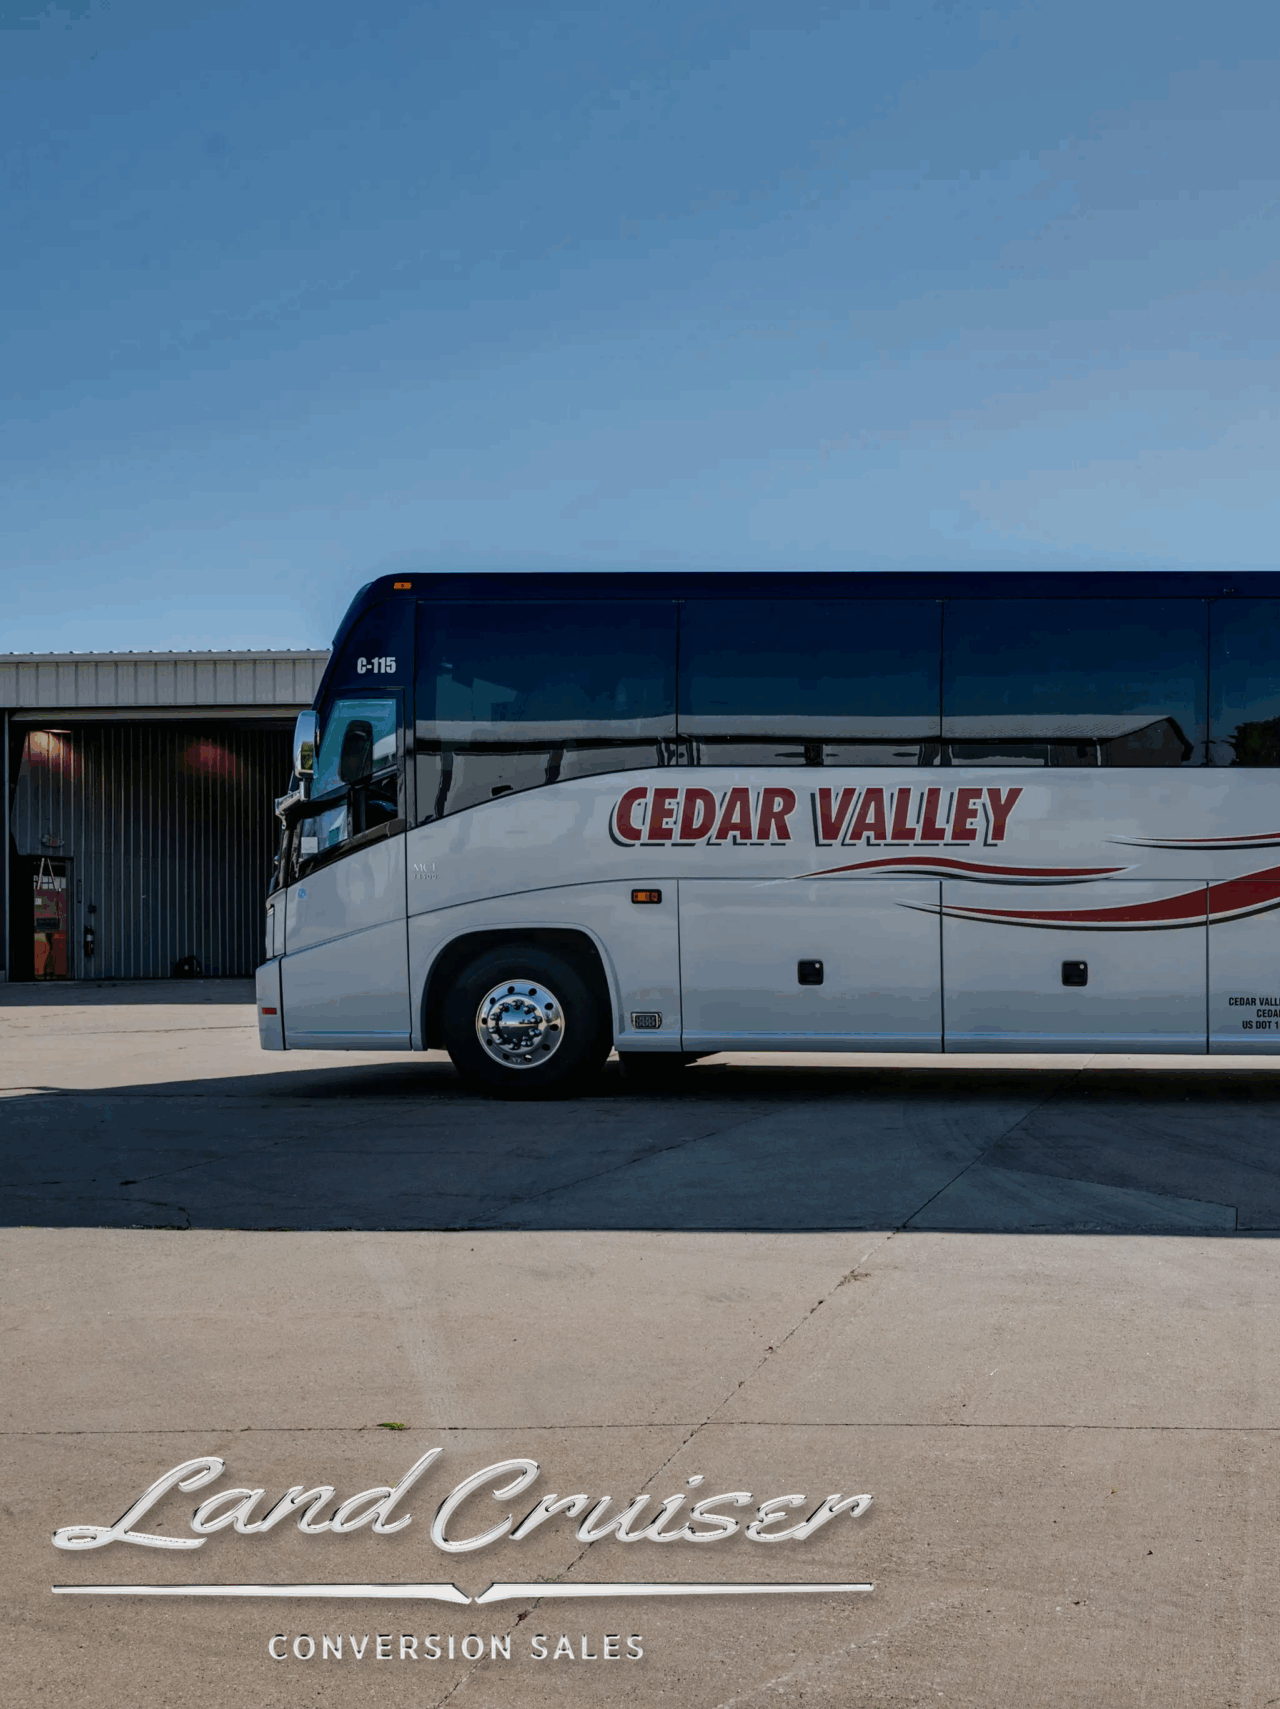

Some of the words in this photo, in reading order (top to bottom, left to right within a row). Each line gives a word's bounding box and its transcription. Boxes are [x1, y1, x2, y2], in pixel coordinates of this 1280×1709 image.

[357, 657, 396, 674] C-115
[608, 786, 796, 847] CEDAR
[810, 786, 1023, 847] VALLEY
[1228, 997, 1257, 1006] CEDAR
[1242, 1021, 1254, 1030] US
[1255, 1021, 1272, 1030] DOT
